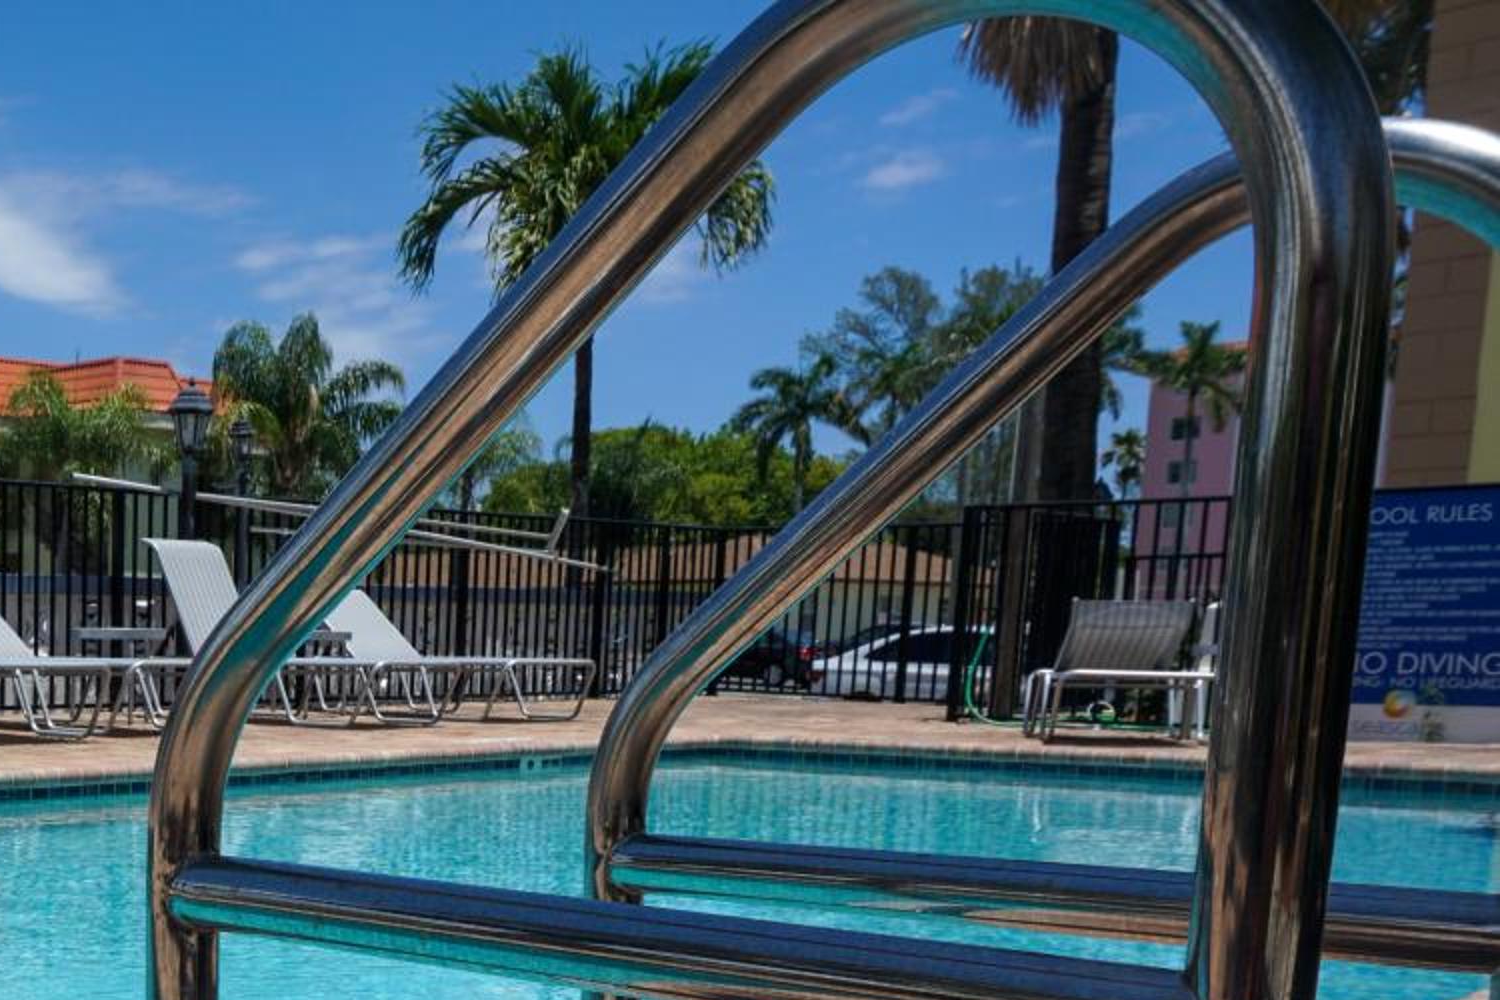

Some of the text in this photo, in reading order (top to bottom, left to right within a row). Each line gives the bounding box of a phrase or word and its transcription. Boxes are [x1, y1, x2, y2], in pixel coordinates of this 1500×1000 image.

[1368, 502, 1493, 525] OOL RULES
[1396, 652, 1500, 675] DIVING
